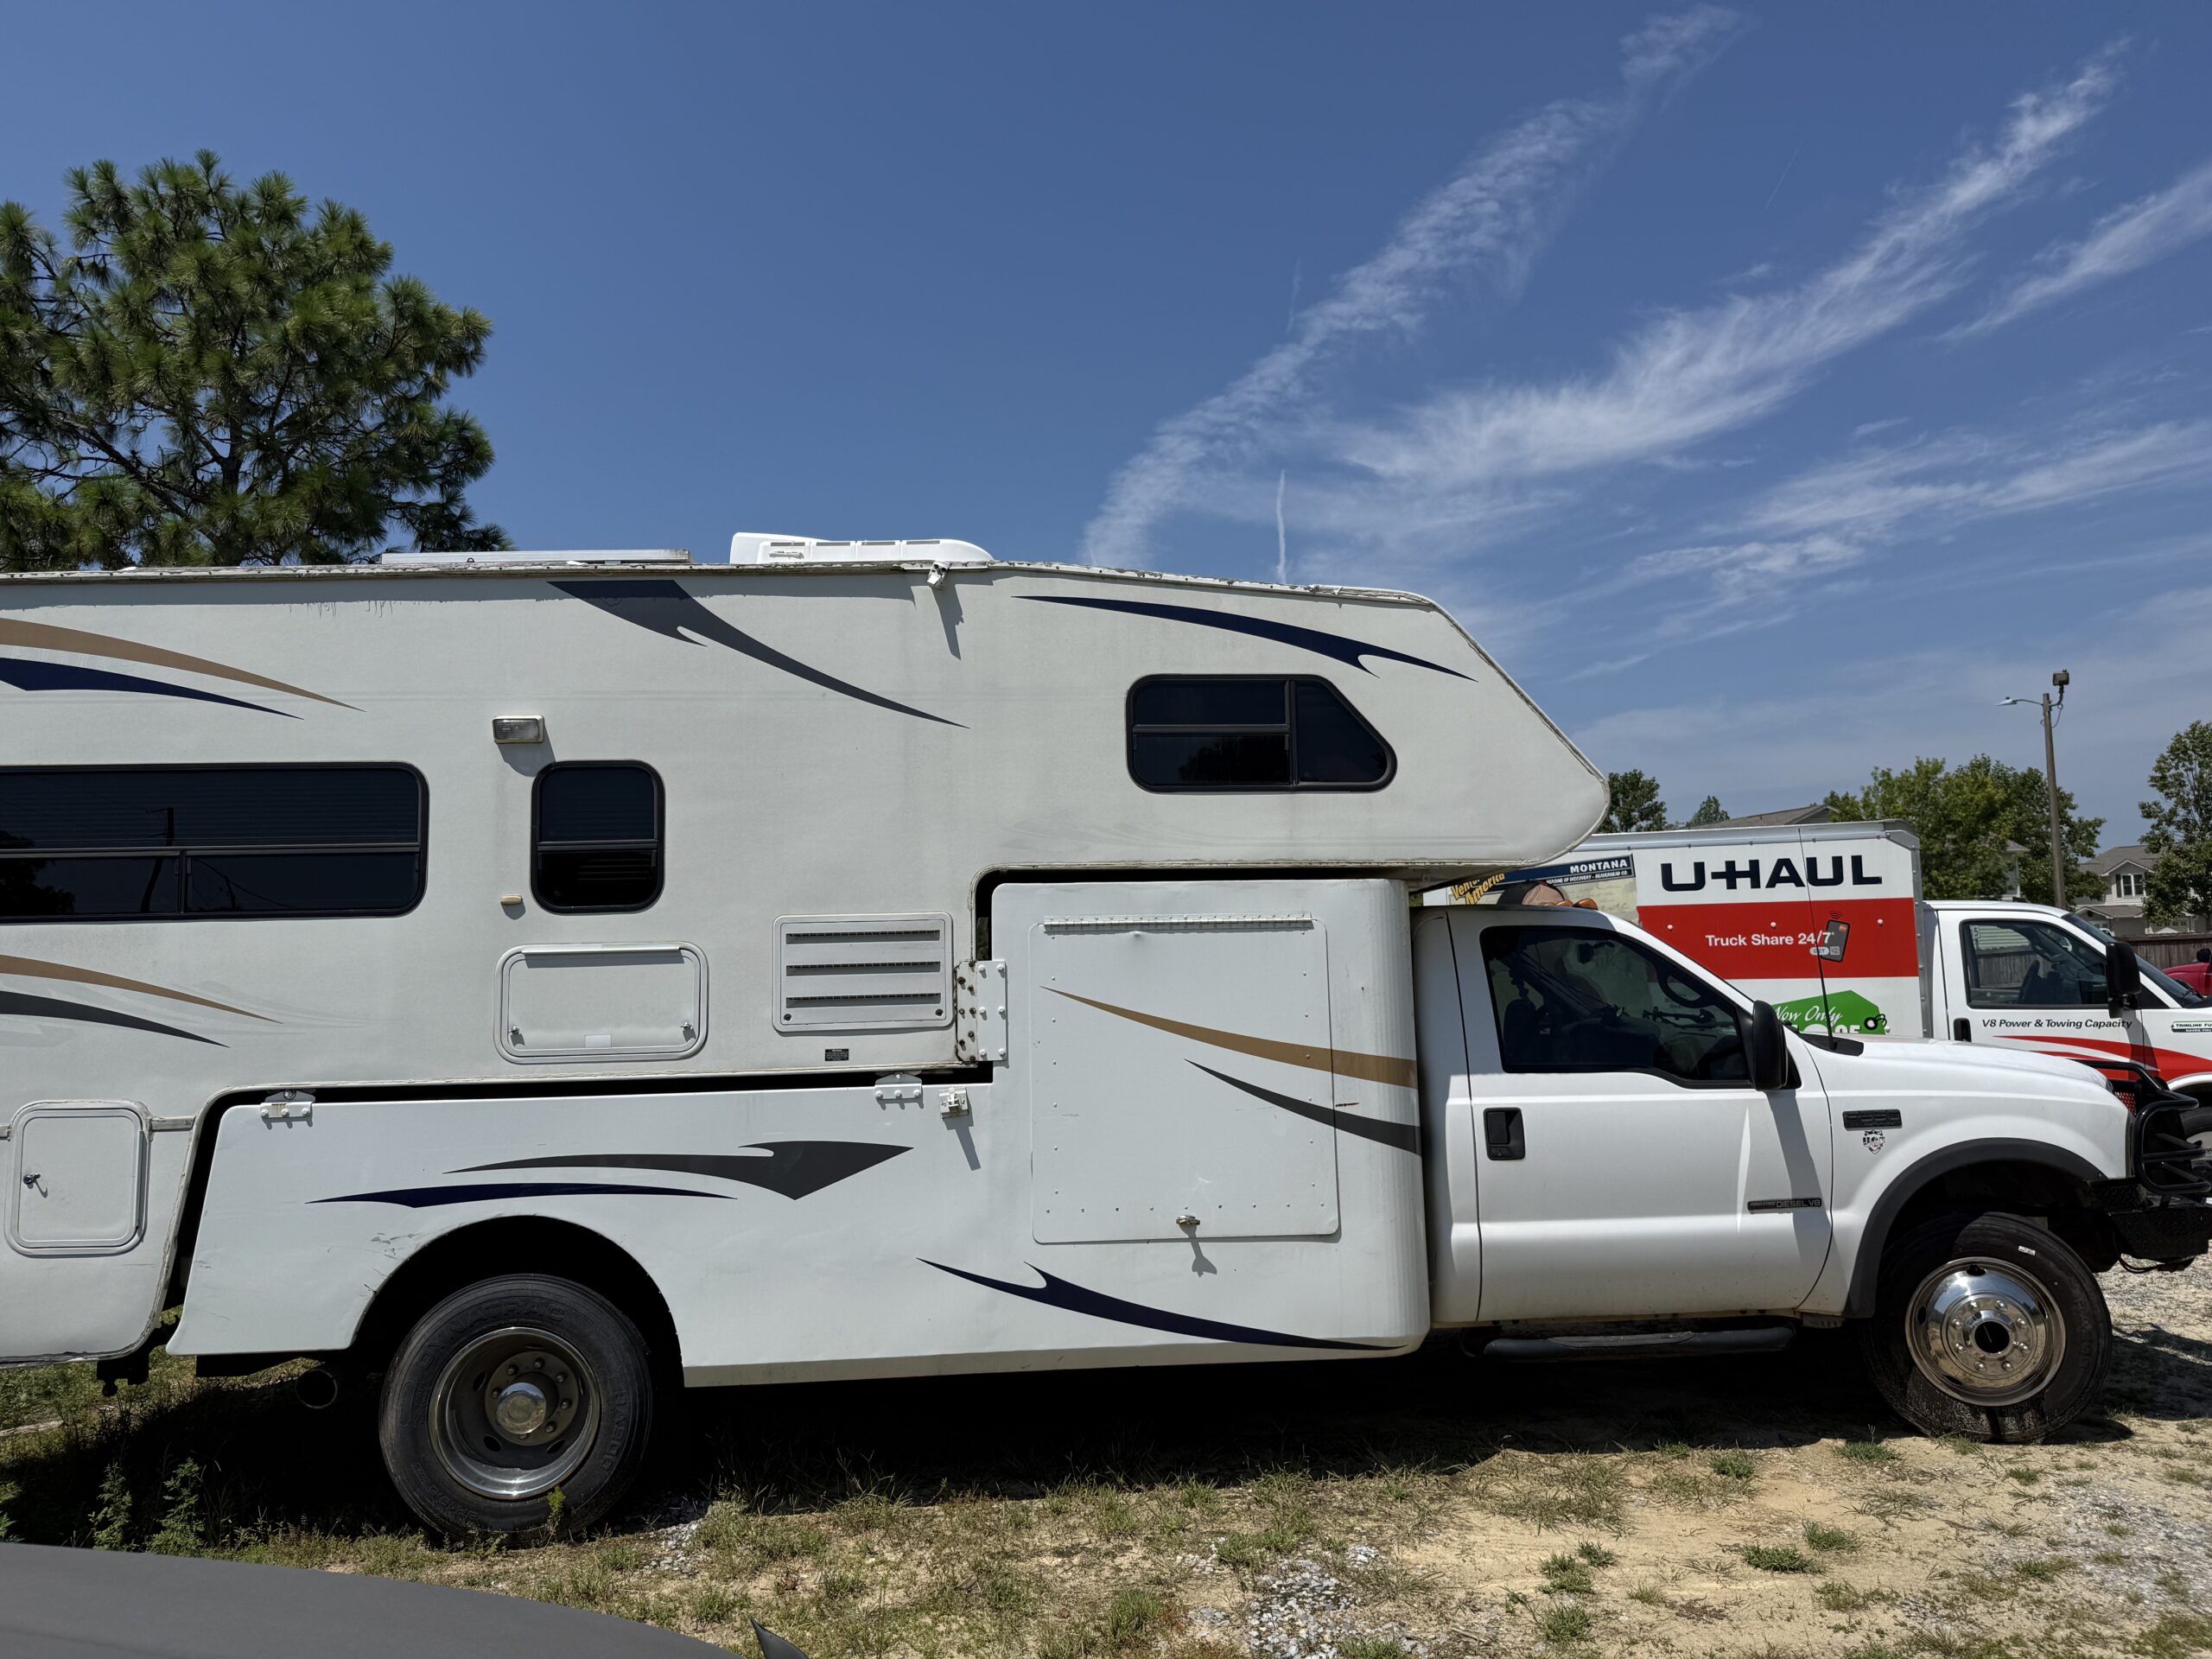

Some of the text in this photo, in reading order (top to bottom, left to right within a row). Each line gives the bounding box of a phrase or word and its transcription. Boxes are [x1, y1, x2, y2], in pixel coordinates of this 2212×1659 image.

[1570, 859, 1628, 874] MONTANA
[1661, 855, 1883, 892] U-HAUL
[1705, 934, 1747, 947] Truck
[1751, 933, 1794, 946] Share
[1775, 1005, 1843, 1027] Now Only
[1982, 1019, 2133, 1029] V8 Power & Towing Capacity
[1776, 1199, 1808, 1208] DIESEL
[416, 1298, 567, 1370] DYNATRAC
